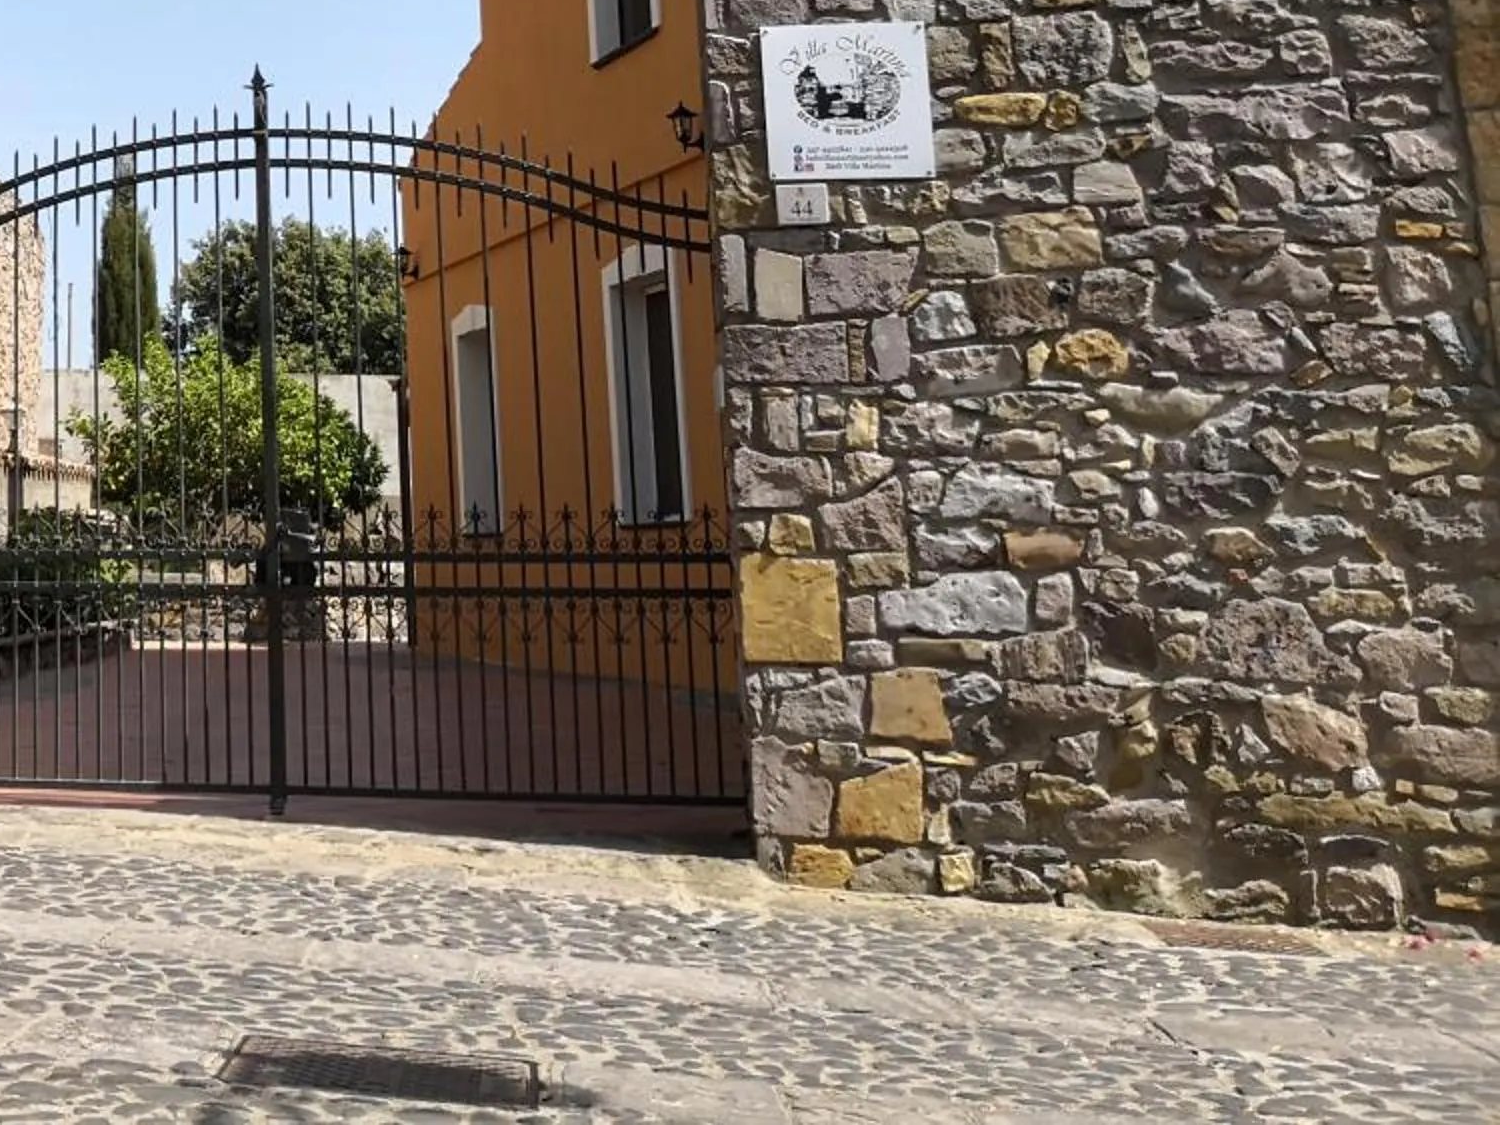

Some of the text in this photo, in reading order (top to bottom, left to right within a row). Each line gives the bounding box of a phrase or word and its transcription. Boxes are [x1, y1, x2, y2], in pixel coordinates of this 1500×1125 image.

[779, 38, 827, 75] Villa
[797, 110, 819, 128] BED
[835, 109, 901, 136] BREAKFAST
[791, 200, 813, 217] 44
